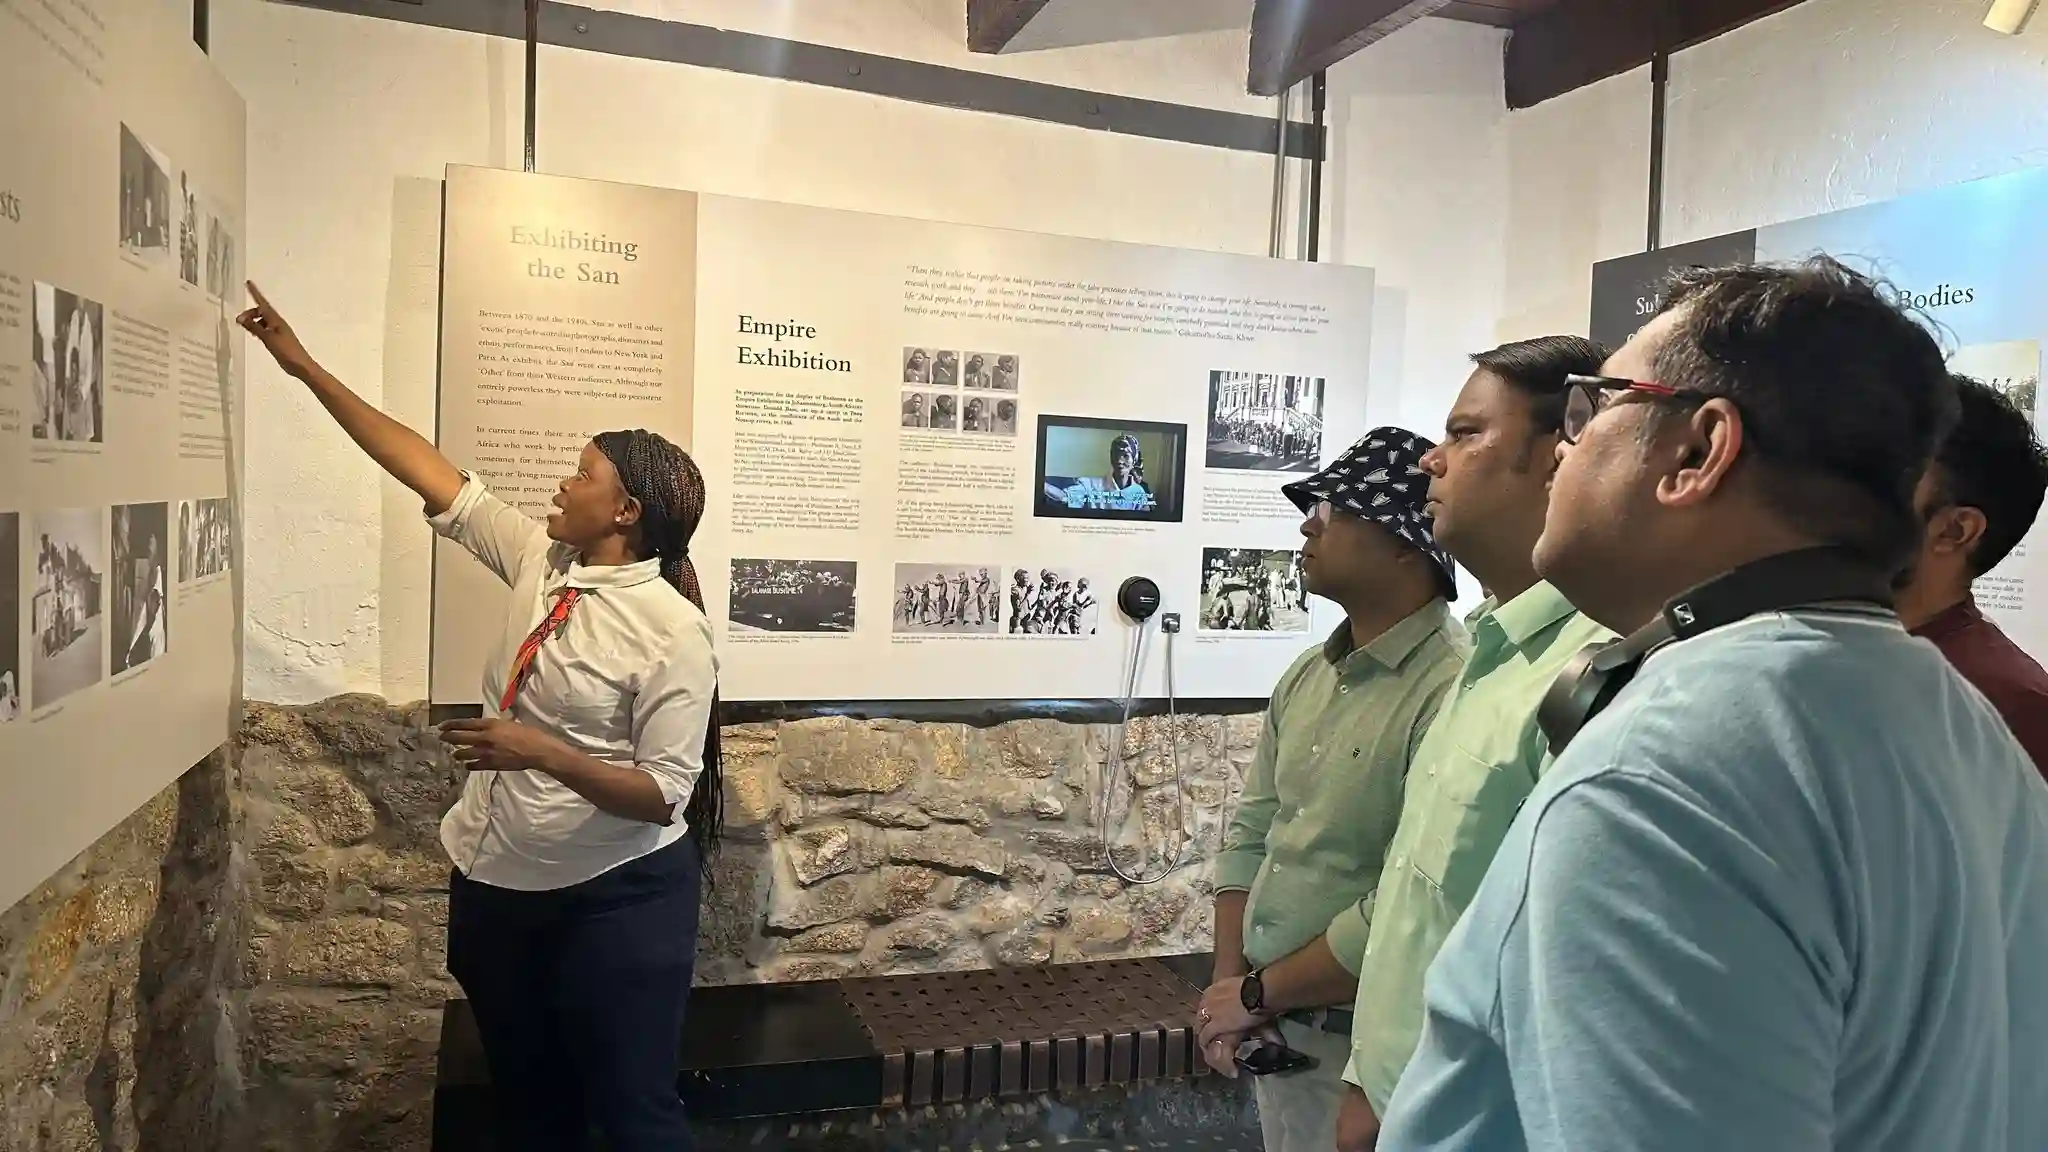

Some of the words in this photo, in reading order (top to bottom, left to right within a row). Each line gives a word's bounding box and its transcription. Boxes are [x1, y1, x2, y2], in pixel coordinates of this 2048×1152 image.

[510, 225, 638, 262] Exhibiting
[528, 258, 566, 280] the
[576, 262, 620, 285] San
[1899, 284, 1974, 308] Bodies
[617, 321, 632, 329] well
[644, 323, 663, 332] other
[738, 314, 816, 342] Empire
[615, 349, 631, 357] New
[632, 350, 649, 359] York
[738, 346, 852, 372] Exhibition
[623, 364, 663, 376] completely
[507, 369, 525, 378] from
[545, 372, 576, 381] Western
[616, 377, 649, 388] Although
[477, 382, 505, 393] entirely
[507, 385, 544, 393] powerless
[584, 389, 617, 399] subjected
[544, 429, 563, 437] there
[476, 440, 500, 448] Africa
[548, 443, 557, 453] by
[476, 468, 503, 478] villages
[492, 485, 520, 493] present
[523, 485, 556, 494] practices
[518, 500, 546, 508] positive
